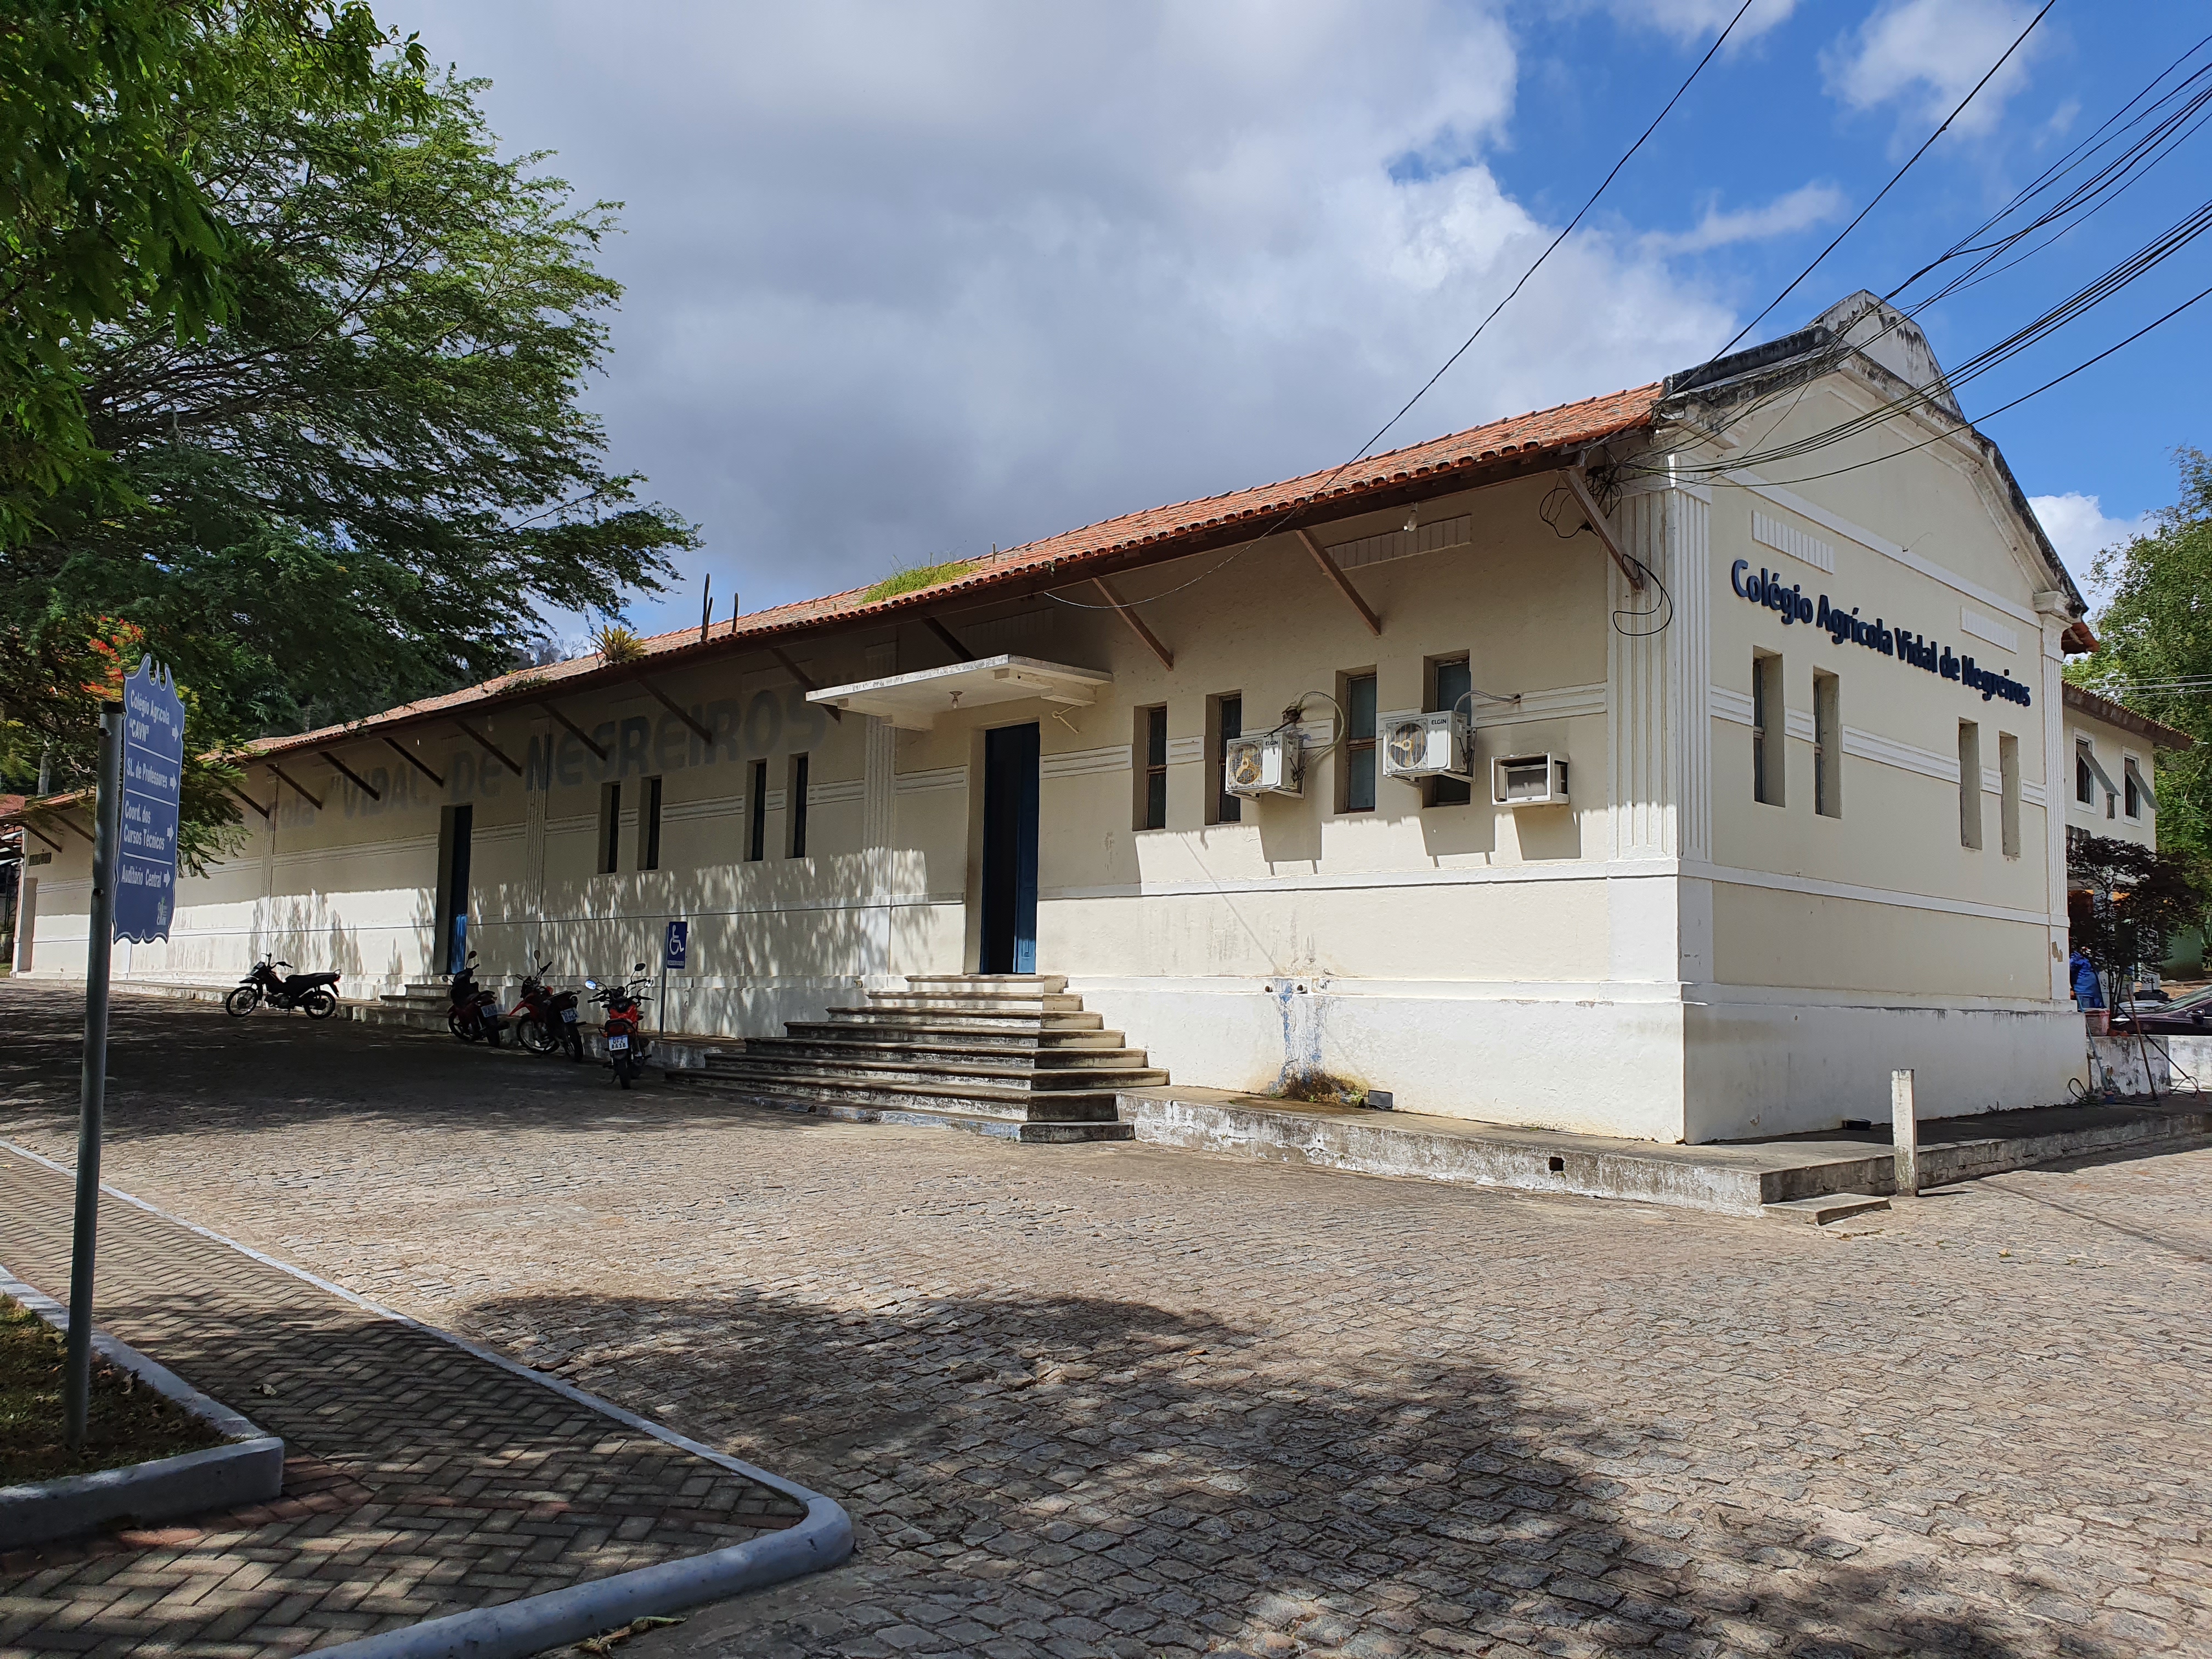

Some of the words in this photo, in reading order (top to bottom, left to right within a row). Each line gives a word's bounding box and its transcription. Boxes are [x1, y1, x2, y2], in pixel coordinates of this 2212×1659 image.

[1731, 559, 1814, 625] Colégio
[1816, 595, 1893, 656] Agrícola
[1894, 628, 1937, 673] Vidal
[1939, 646, 1960, 680] de
[1961, 655, 2030, 707] Negreiros
[130, 689, 150, 718] Colégio
[150, 699, 170, 725] Agrícola
[127, 757, 135, 777] SL.
[136, 760, 142, 780] de
[142, 762, 167, 789] Professores
[125, 799, 142, 822] Coord.
[142, 805, 151, 825] dos
[124, 823, 142, 845] Cursos
[143, 828, 165, 850] Técnicos
[121, 864, 144, 885] Auditório
[145, 868, 162, 888] Central
